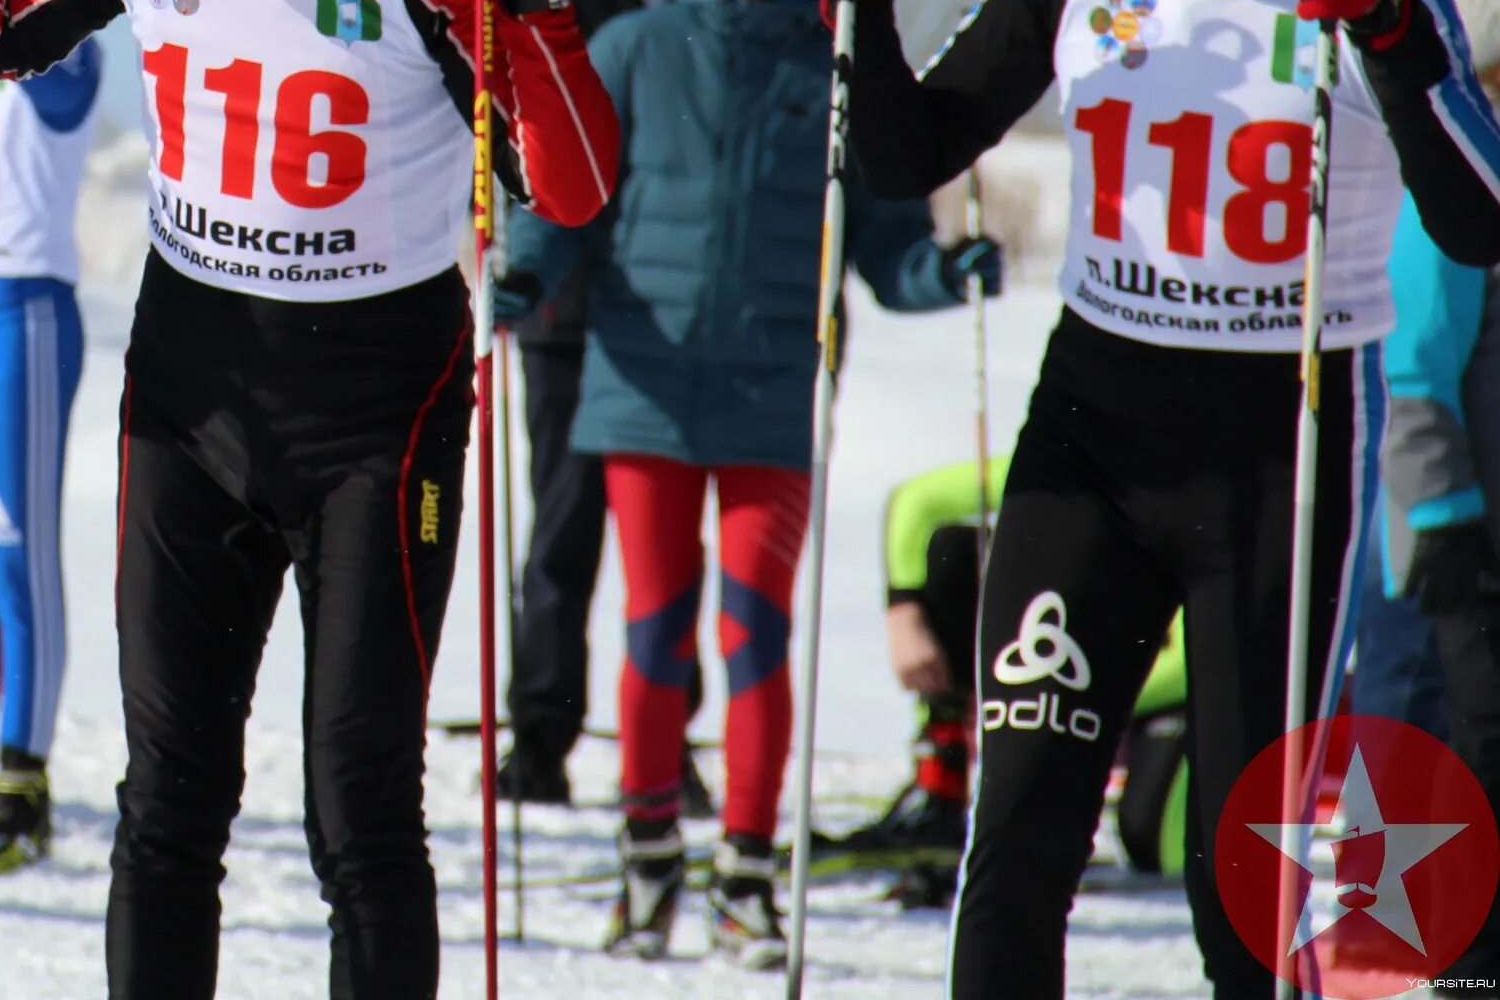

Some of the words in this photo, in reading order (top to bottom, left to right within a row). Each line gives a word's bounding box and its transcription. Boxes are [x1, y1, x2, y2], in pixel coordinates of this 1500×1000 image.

[143, 42, 369, 210] 116
[1074, 96, 1314, 264] 118
[268, 261, 388, 283] область
[1228, 309, 1353, 333] облать
[982, 692, 1102, 742] odlo
